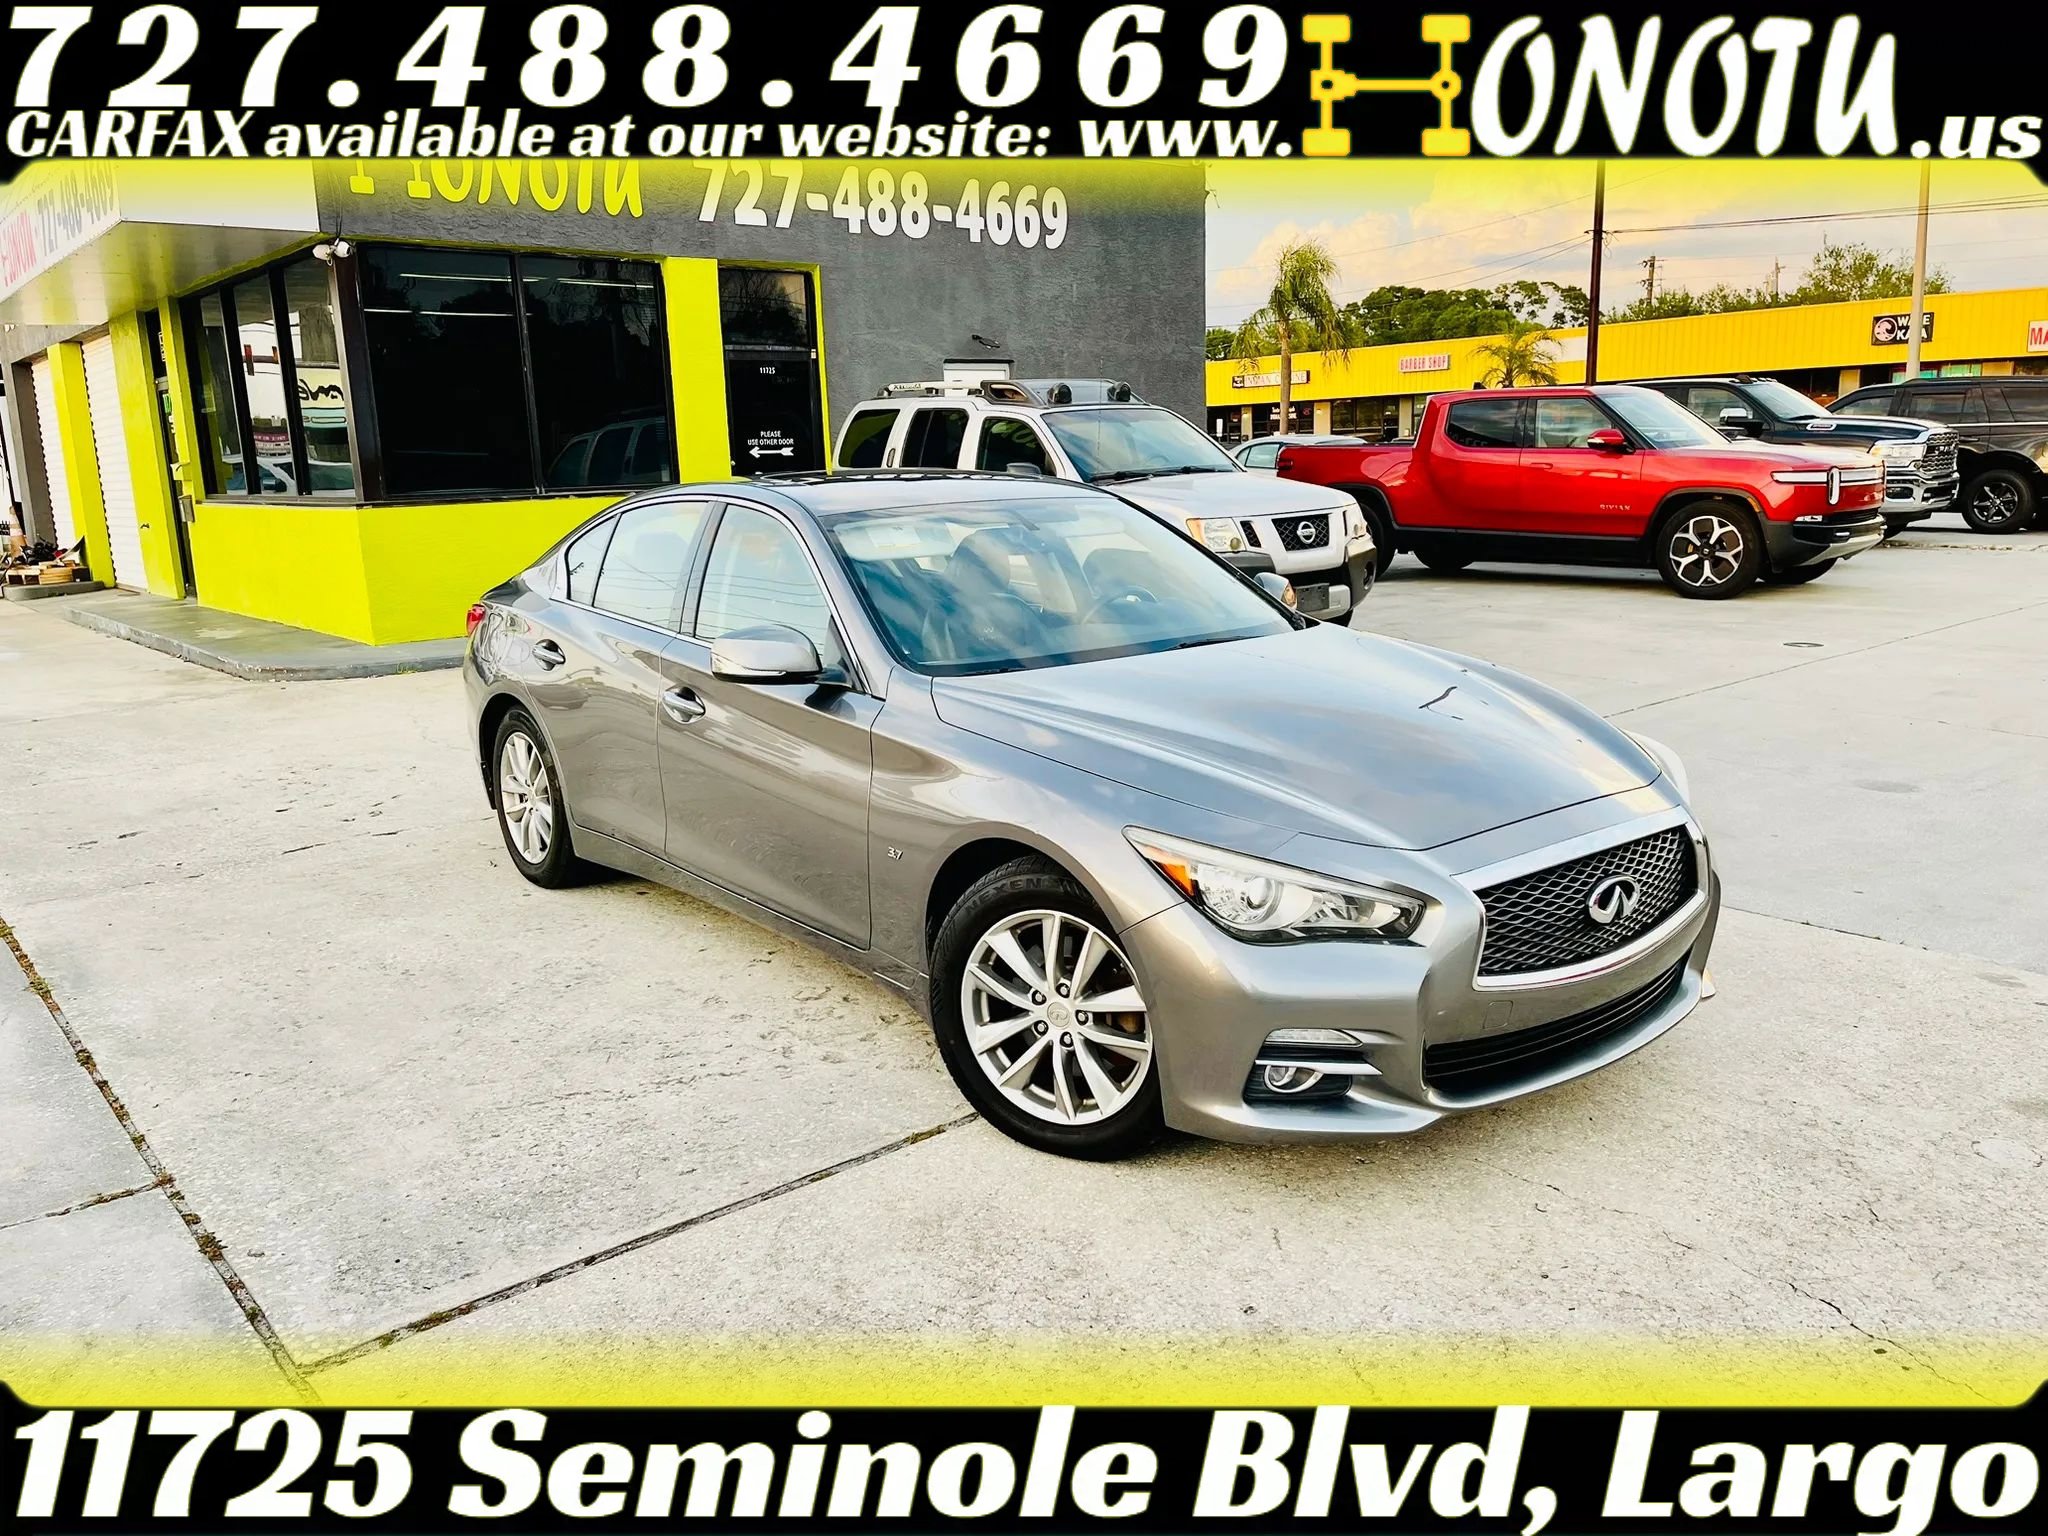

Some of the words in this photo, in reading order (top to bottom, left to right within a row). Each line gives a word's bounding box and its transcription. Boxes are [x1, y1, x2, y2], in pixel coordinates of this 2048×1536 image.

[694, 160, 1069, 250] 727-488-4669
[1897, 314, 1931, 327] WE
[1896, 328, 1928, 341] KA
[1428, 355, 1446, 369] SHOP
[760, 366, 775, 374] 11725
